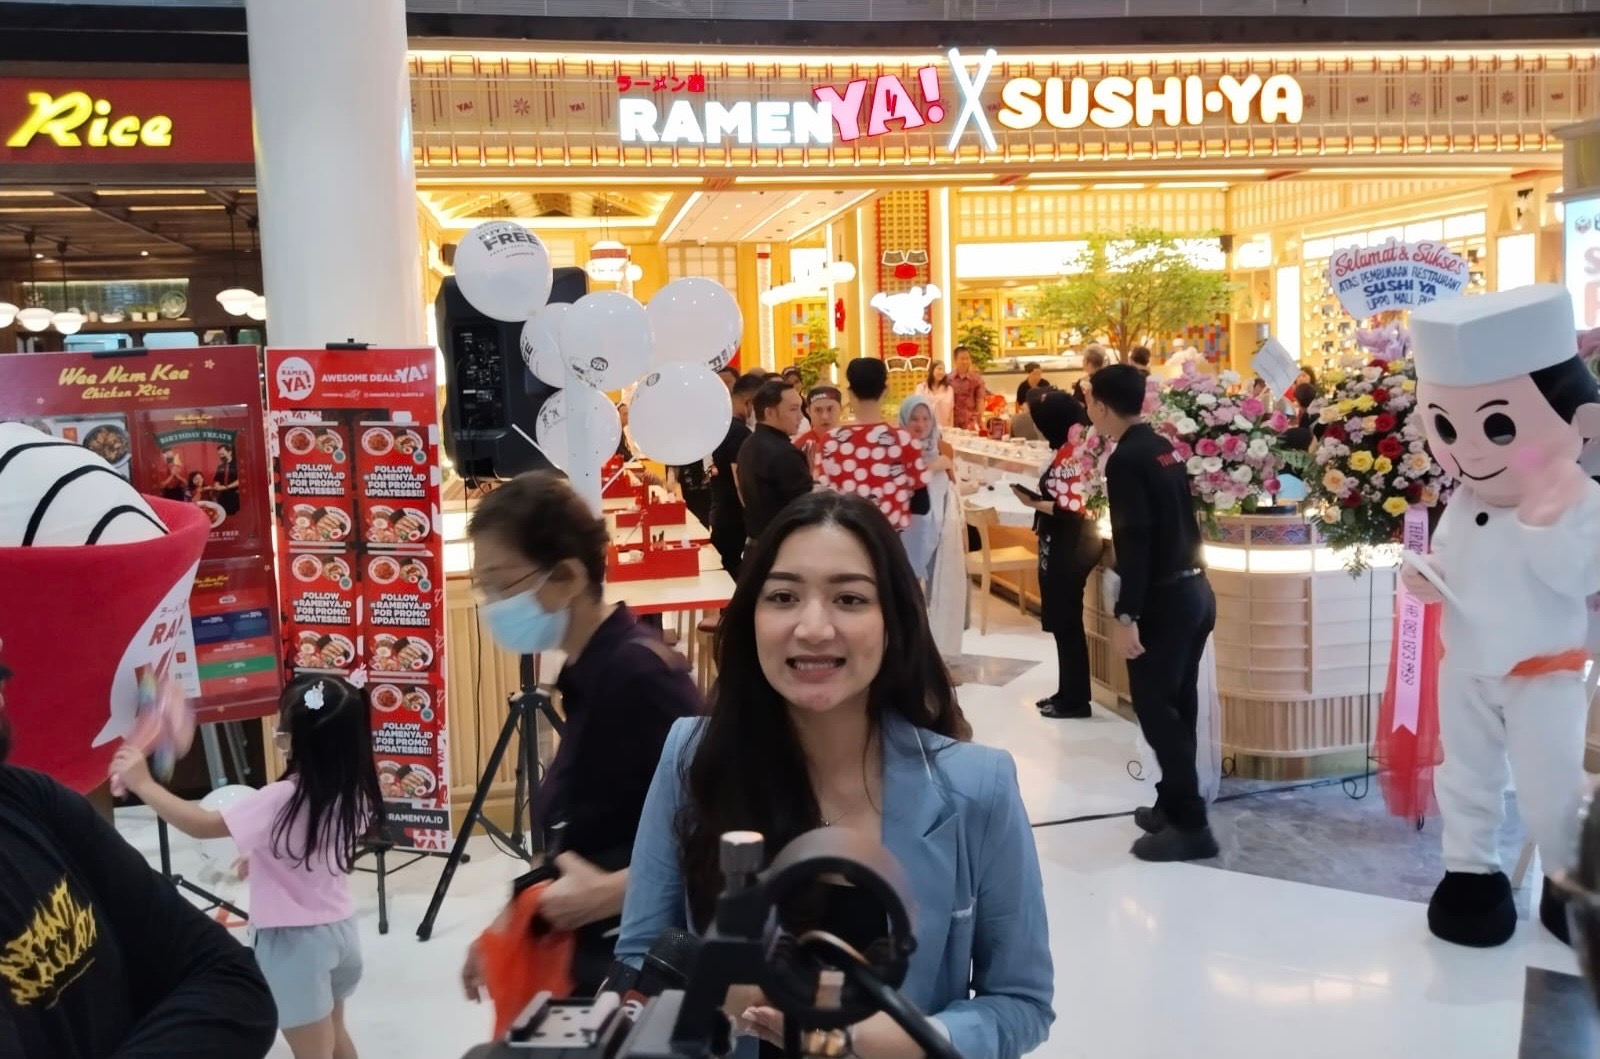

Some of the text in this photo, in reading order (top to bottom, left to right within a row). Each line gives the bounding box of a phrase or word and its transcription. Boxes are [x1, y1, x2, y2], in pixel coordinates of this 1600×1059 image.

[619, 97, 833, 146] RAMEN
[813, 66, 944, 142] YA!
[7, 91, 173, 148] Rice
[484, 232, 540, 251] FREE
[1335, 241, 1465, 278] Selamat & Sukses
[1363, 279, 1437, 298] SUSHI YA
[58, 363, 190, 386] Wee Nam Kee
[322, 373, 368, 383] AWESOME
[282, 374, 312, 392] YA!
[81, 387, 132, 400] Chicken
[134, 384, 171, 397] Rice
[159, 430, 232, 445] BIRTHDAY TREATS
[295, 463, 332, 471] FOLLOW
[374, 465, 412, 473] FOLLOW
[290, 479, 340, 488] FOR PROMO
[368, 481, 422, 490] FOR PROMO
[303, 592, 339, 600] FOLLOW
[380, 593, 418, 601] FOLLOW
[296, 607, 347, 617] FOR PROMO
[373, 610, 427, 619] FOR PROMO
[382, 722, 420, 731] FOLLOW
[375, 738, 429, 747] FOR PROMO
[388, 812, 444, 824] RAMENYA.ID
